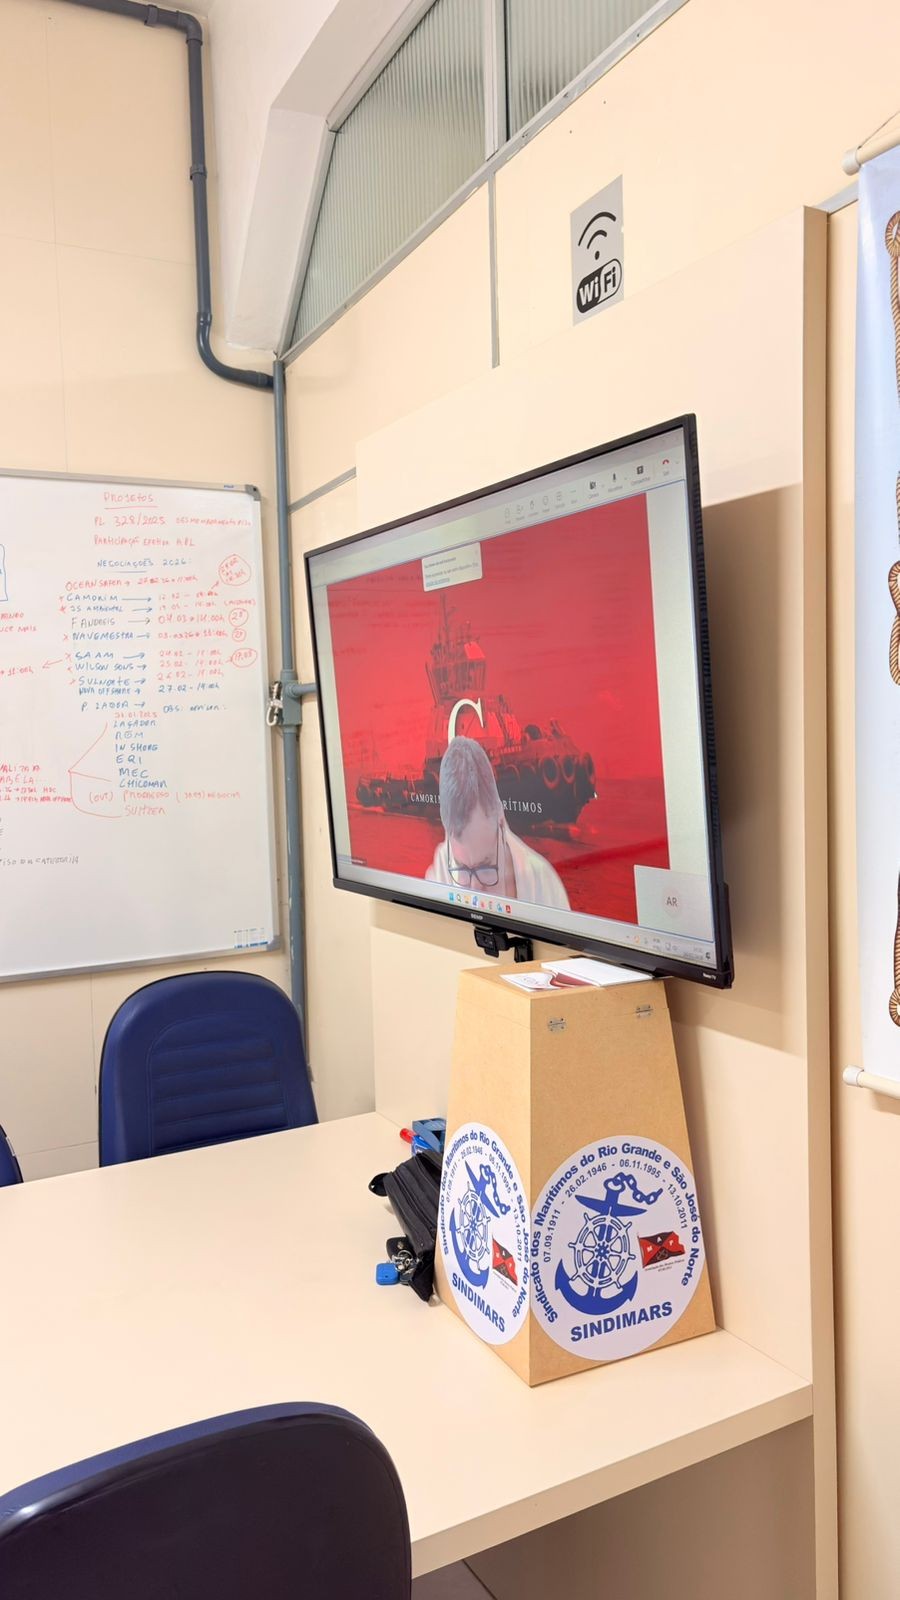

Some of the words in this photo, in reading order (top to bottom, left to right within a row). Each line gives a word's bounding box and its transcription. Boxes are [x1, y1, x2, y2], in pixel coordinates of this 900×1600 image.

[410, 792, 440, 804] CAMORI
[666, 896, 678, 907] AR
[479, 1131, 490, 1146] Rio
[491, 1140, 513, 1180] Grande
[580, 1154, 595, 1167] do
[597, 1144, 618, 1158] Rio
[621, 1142, 662, 1163] Grande
[663, 1160, 671, 1169] e
[671, 1166, 687, 1190] São
[534, 1164, 579, 1227] Marítimos
[685, 1192, 700, 1222] José
[543, 1209, 561, 1263] 07.09.1911
[564, 1162, 607, 1198] 26.02.1946
[619, 1159, 661, 1178] 06.11.1995
[667, 1183, 688, 1229] 13.10.2011
[530, 1231, 541, 1257] dos
[691, 1226, 701, 1243] do
[681, 1247, 700, 1286] Norte
[451, 1272, 505, 1333] SINDIMARS
[530, 1261, 558, 1323] Sindicato
[570, 1301, 672, 1342] SINDIMARS
